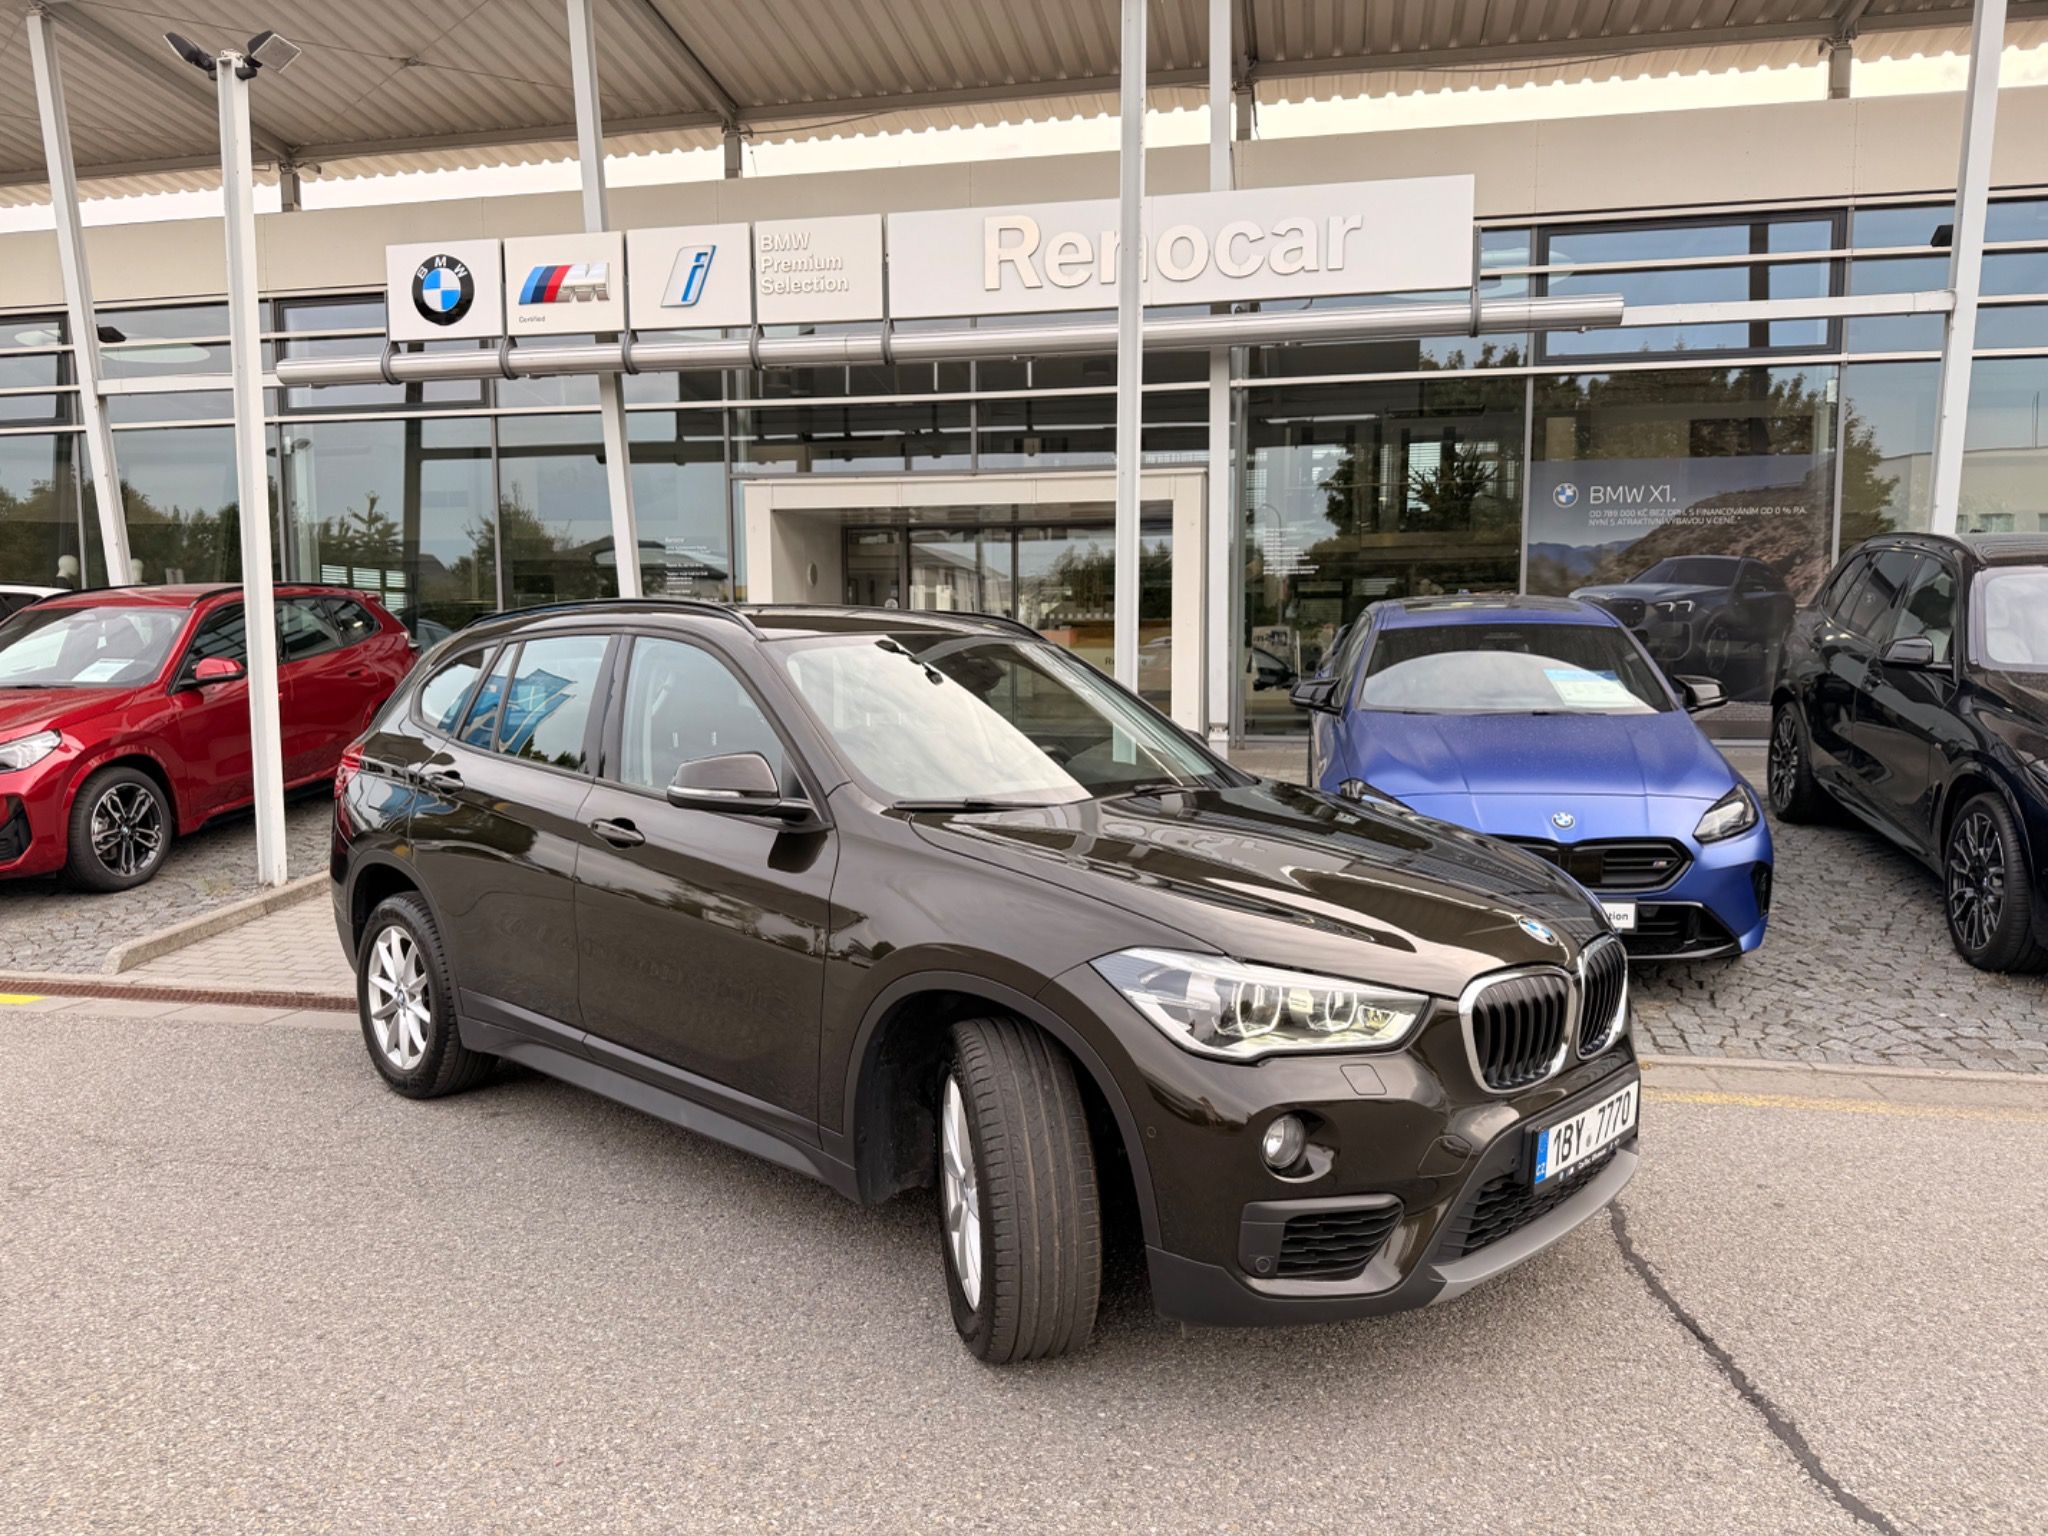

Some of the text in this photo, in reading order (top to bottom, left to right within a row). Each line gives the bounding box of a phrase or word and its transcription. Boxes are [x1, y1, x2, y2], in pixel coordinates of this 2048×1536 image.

[761, 232, 811, 251] BMW
[984, 213, 1363, 291] Renocar
[416, 255, 468, 280] BMW
[761, 254, 843, 274] Premium
[761, 275, 850, 295] Selection
[1590, 485, 1645, 504] BMW
[1608, 911, 1629, 921] tion
[1553, 1116, 1586, 1167] 1BY
[1596, 1090, 1631, 1144] 7770
